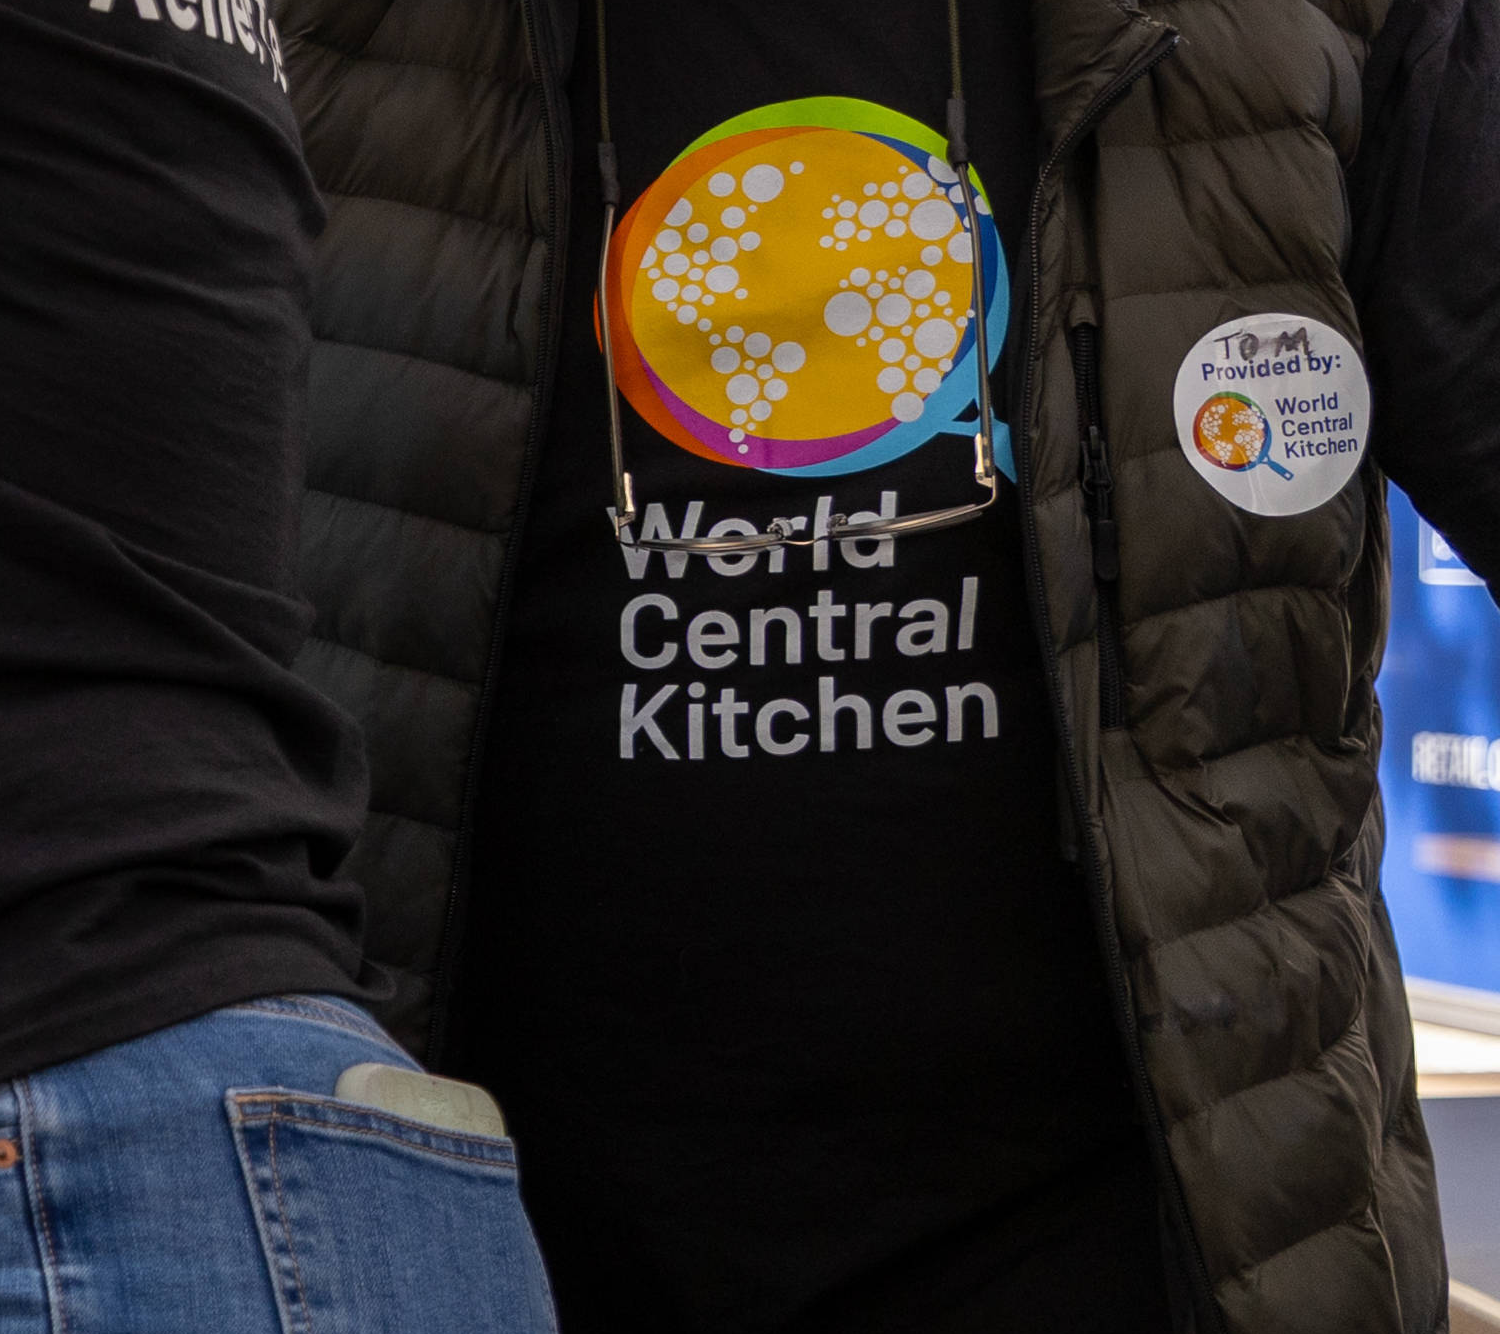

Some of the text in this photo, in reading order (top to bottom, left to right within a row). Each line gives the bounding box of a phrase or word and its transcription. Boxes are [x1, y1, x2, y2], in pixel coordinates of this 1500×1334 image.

[1213, 326, 1313, 362] TOM
[1201, 353, 1342, 382] Provided by:
[1275, 392, 1339, 416] World
[1281, 413, 1353, 437] Central
[1284, 437, 1359, 459] Kitchen
[605, 491, 898, 581] World
[618, 576, 979, 669] Central
[618, 676, 1000, 761] Kitchen
